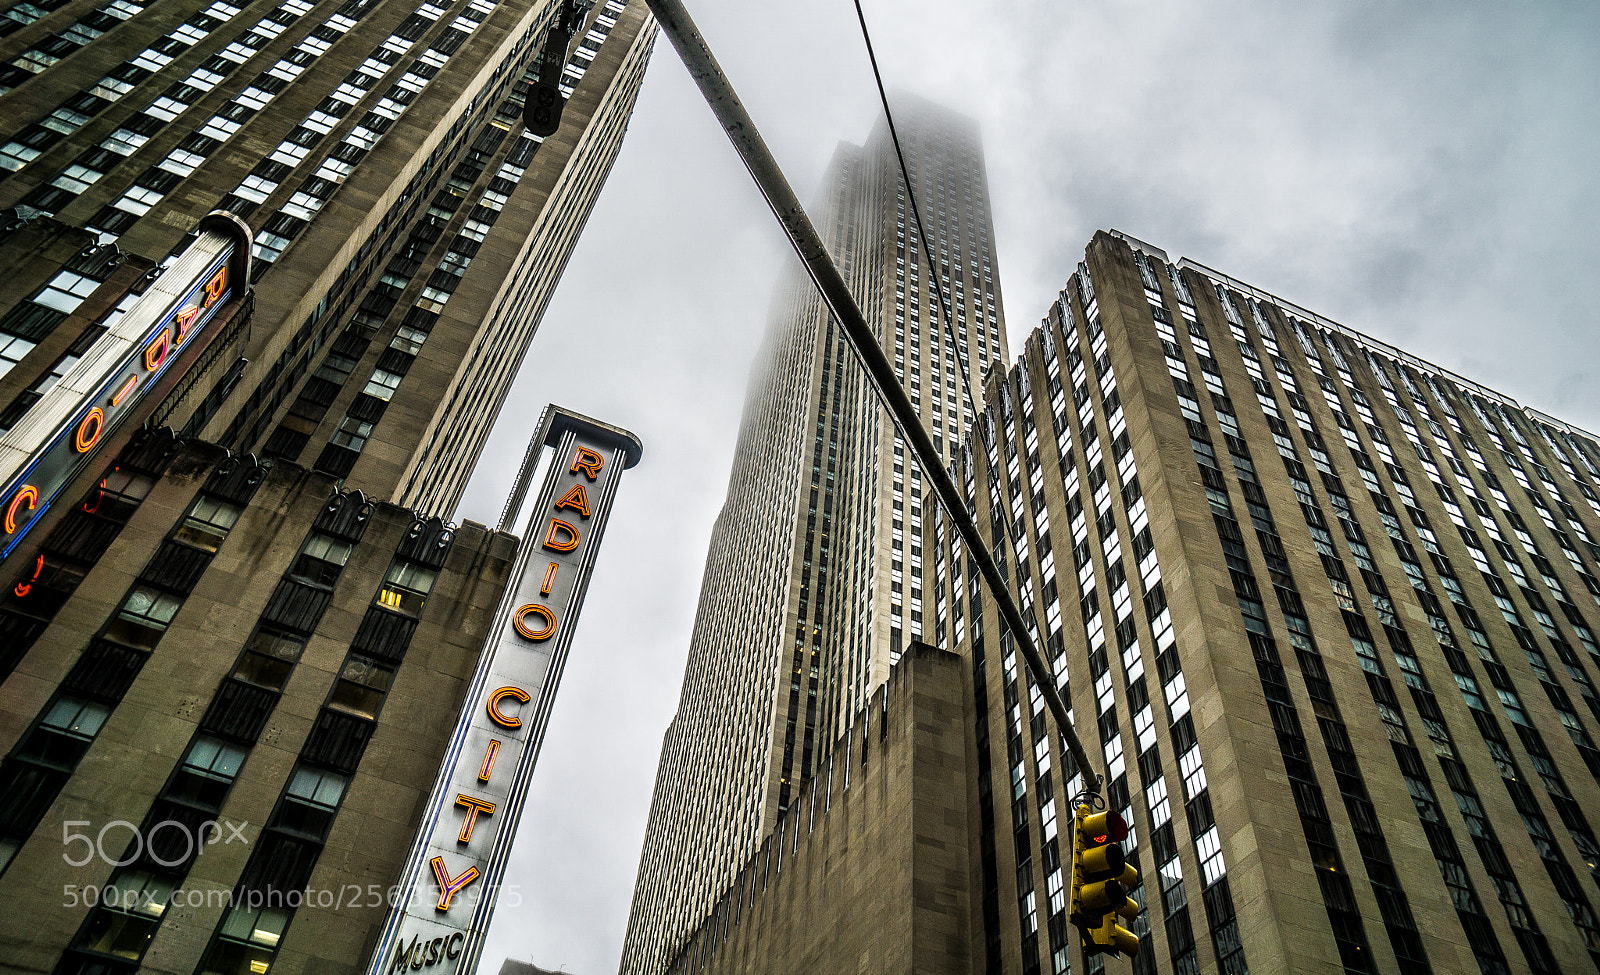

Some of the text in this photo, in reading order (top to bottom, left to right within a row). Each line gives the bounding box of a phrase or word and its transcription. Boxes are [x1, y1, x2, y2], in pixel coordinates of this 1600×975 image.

[75, 266, 226, 454] RADIO
[430, 446, 605, 912] RADIO CITY
